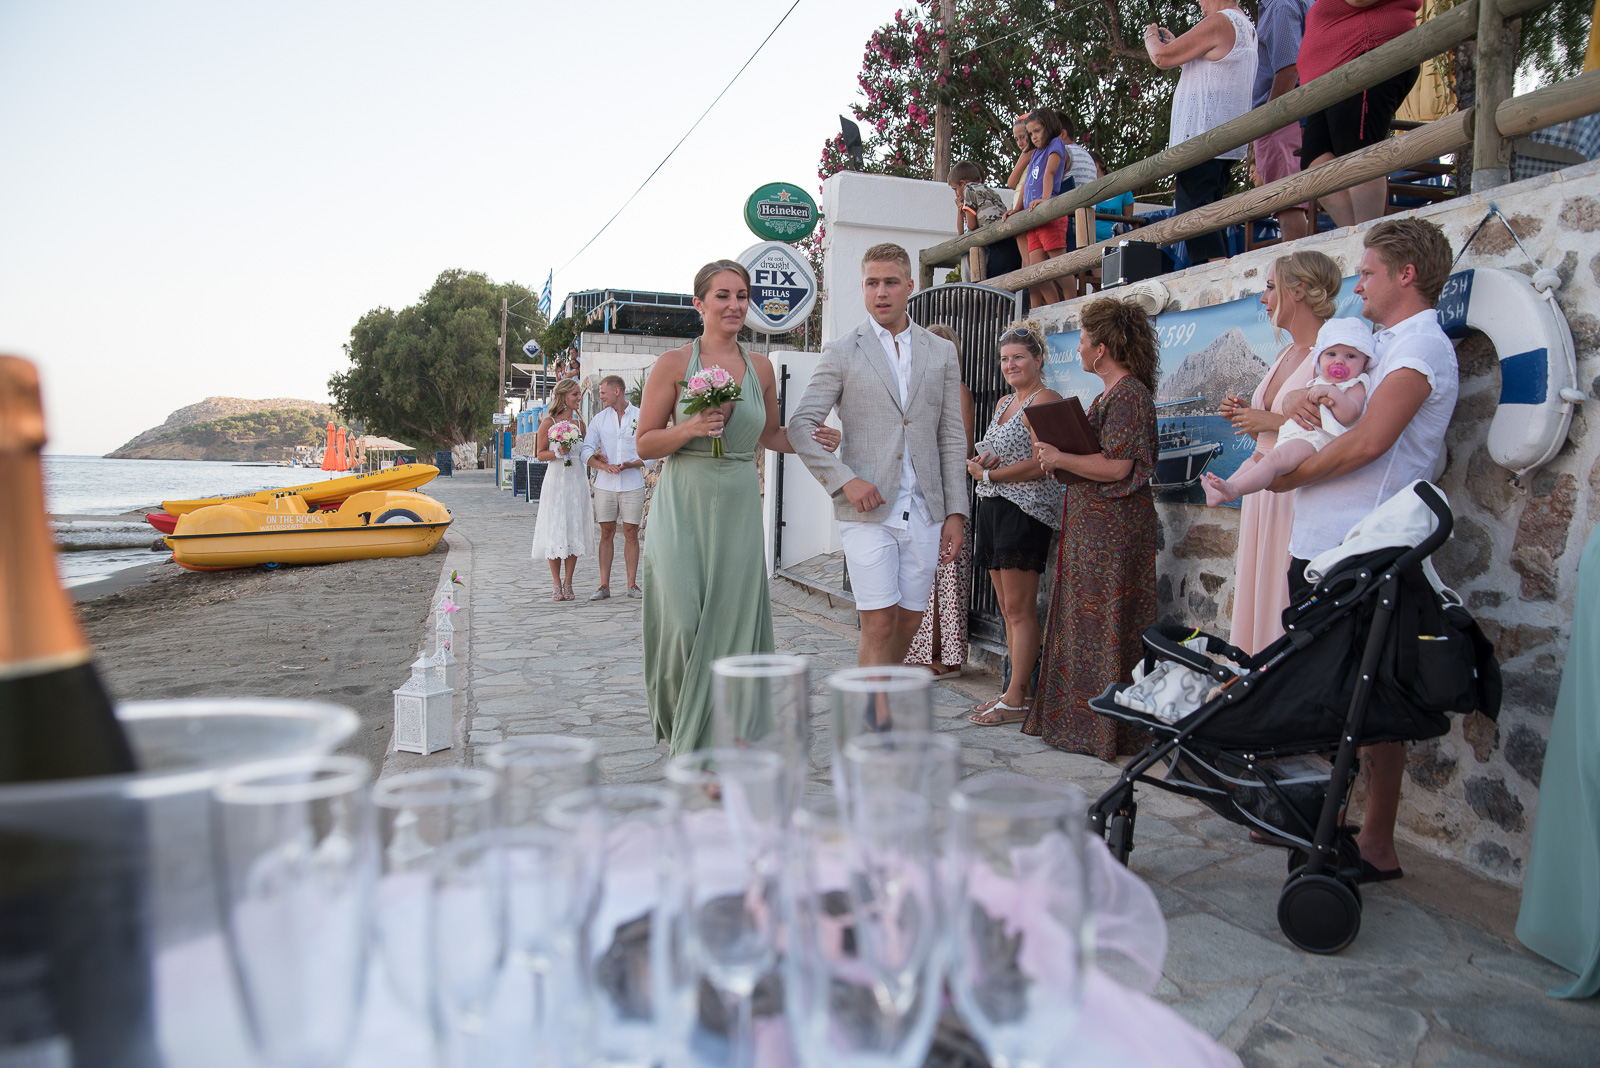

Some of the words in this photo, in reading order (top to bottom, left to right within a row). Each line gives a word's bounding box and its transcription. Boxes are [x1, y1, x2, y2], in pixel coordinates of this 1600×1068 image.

[761, 205, 808, 217] Heineken
[760, 260, 790, 271] draught
[755, 269, 798, 287] FIX
[761, 289, 790, 298] HELLAS
[1438, 275, 1469, 301] ESH
[274, 499, 279, 510] 1
[266, 515, 277, 524] ON
[279, 515, 294, 524] THE
[295, 514, 323, 524] ROCKS
